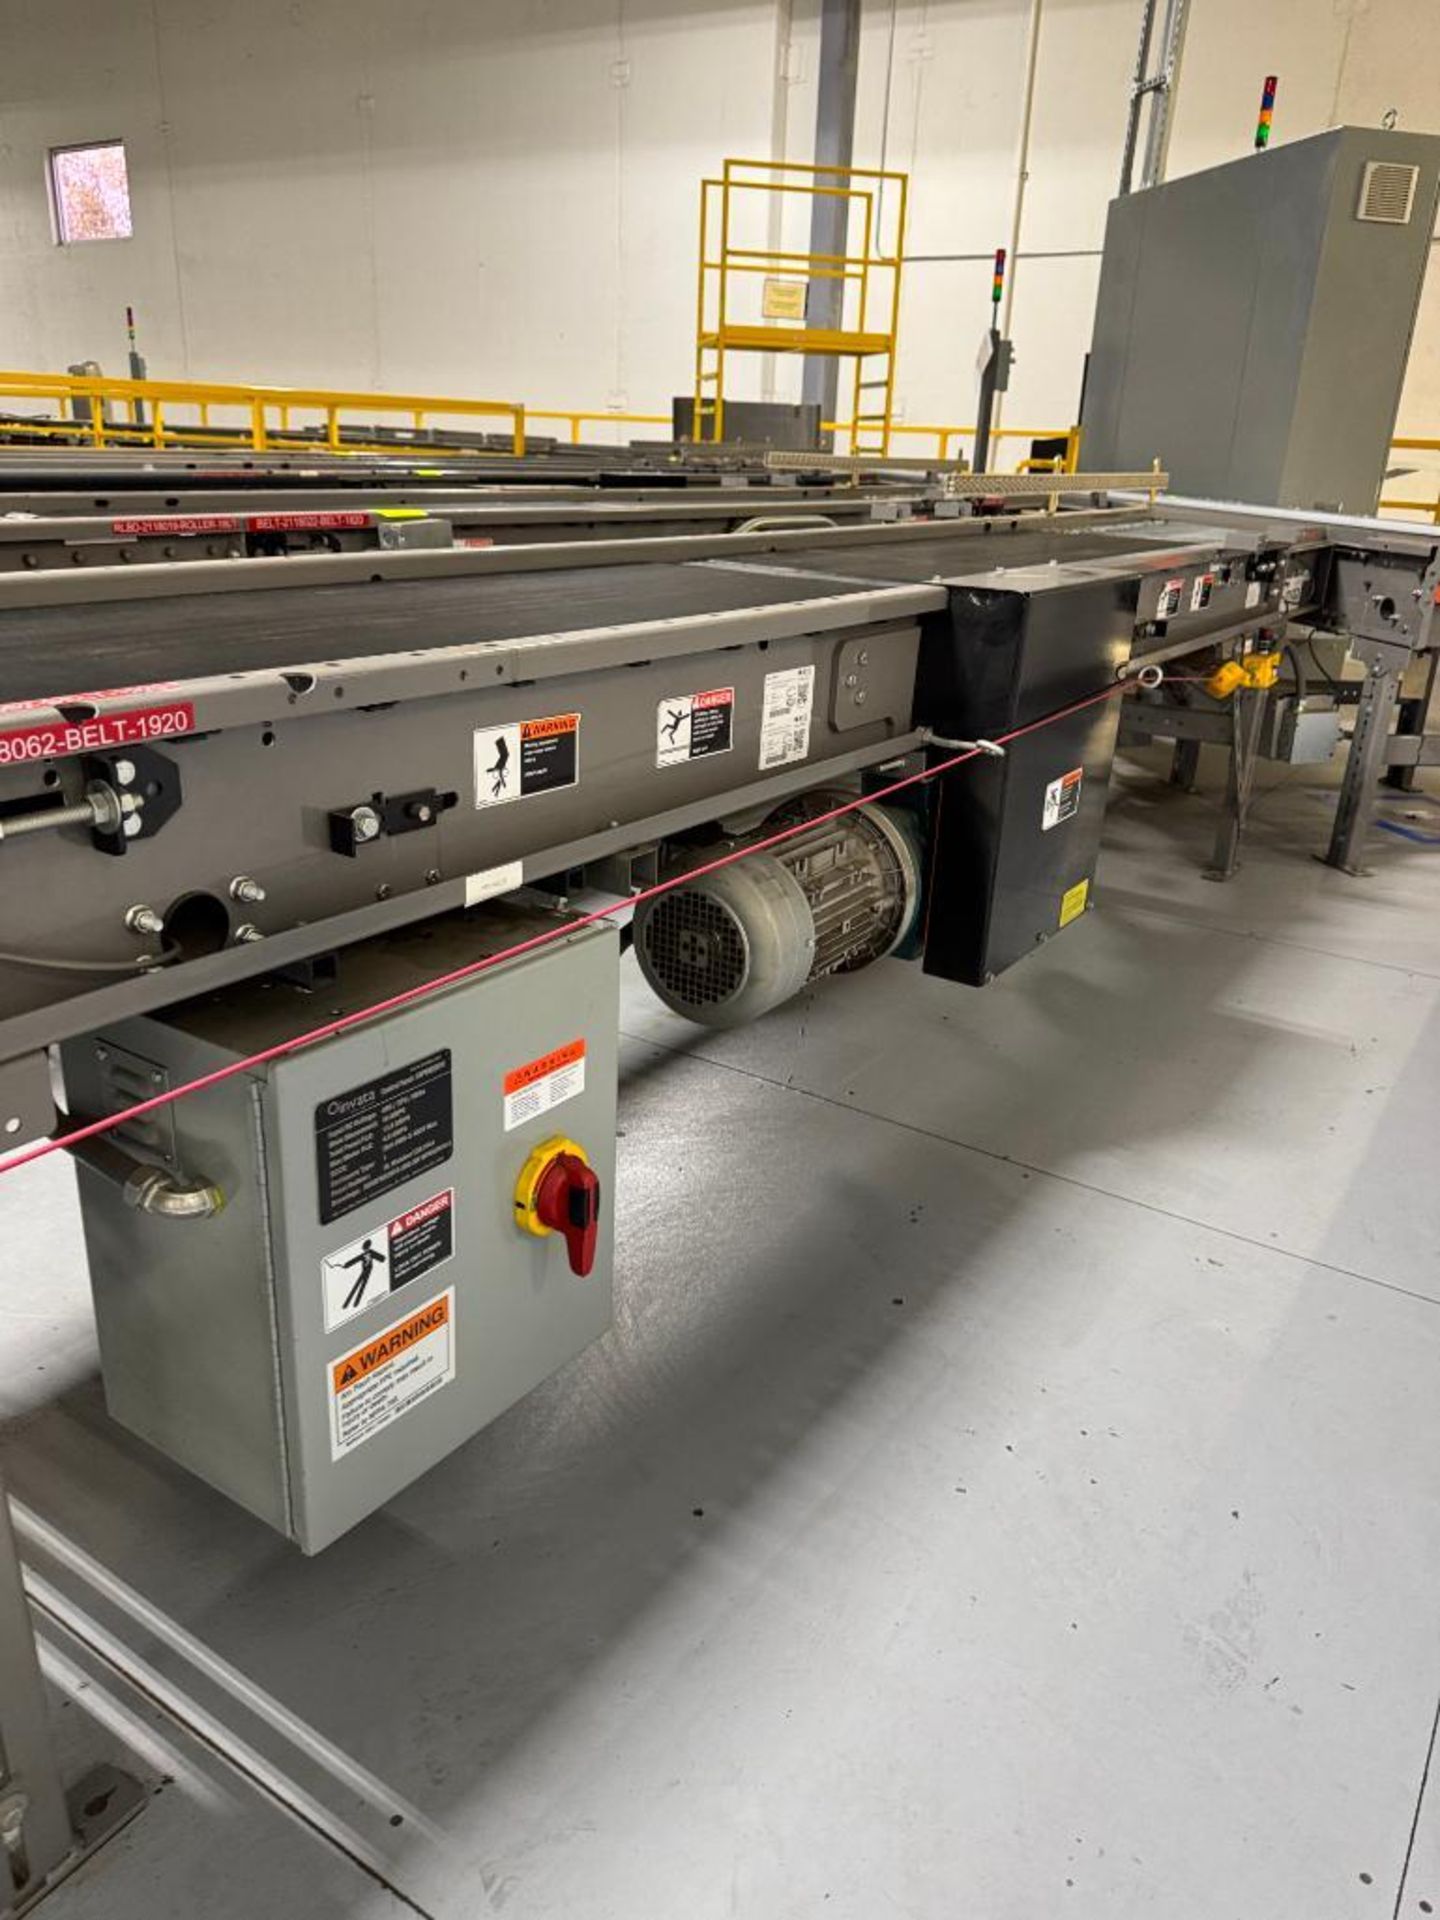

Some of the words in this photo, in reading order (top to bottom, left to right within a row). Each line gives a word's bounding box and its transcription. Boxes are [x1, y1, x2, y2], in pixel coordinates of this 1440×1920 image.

[0, 710, 188, 763] 8062-BELT-1920
[405, 1195, 449, 1227] DANGER
[359, 1306, 445, 1371] WARNING
